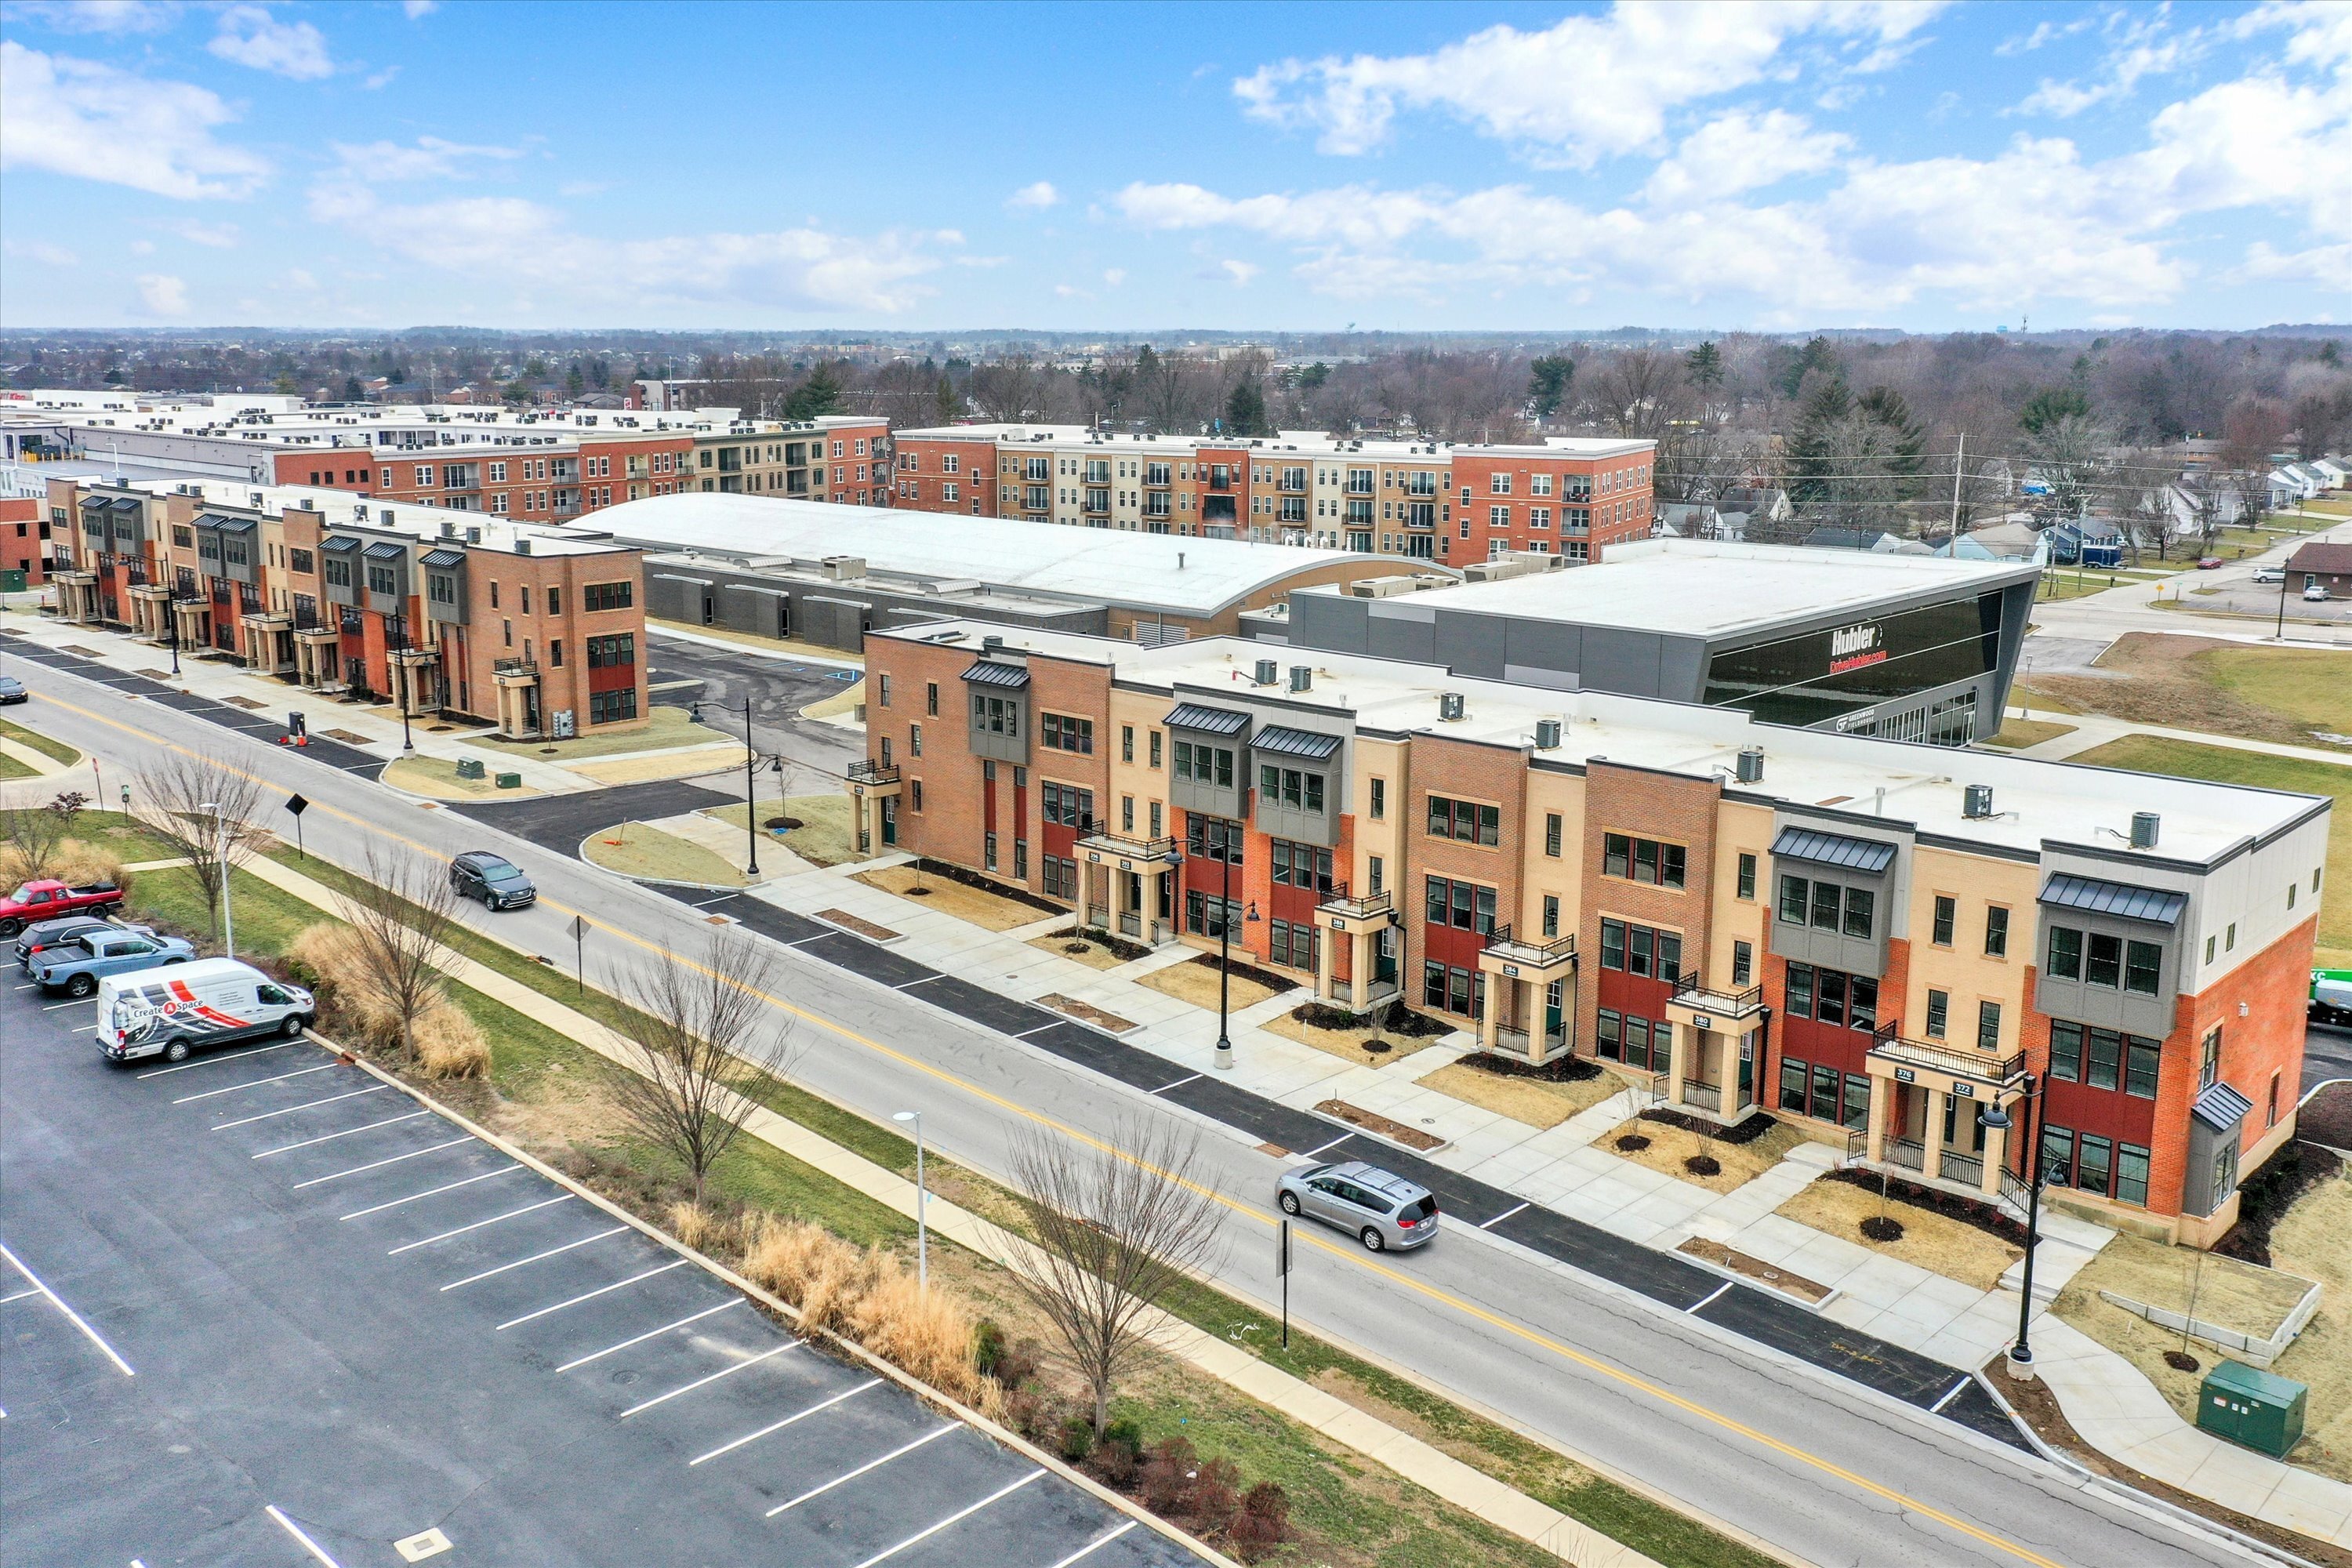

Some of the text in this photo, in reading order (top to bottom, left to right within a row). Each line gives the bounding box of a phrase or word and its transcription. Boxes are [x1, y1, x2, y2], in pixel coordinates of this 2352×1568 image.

[1831, 625, 1875, 657] Hubler
[1829, 650, 1887, 673] DriveHubler.com
[1849, 709, 1875, 721] GREENWOOD
[1848, 716, 1875, 728] FIELDHOUSE
[133, 1007, 163, 1018] Create
[176, 1000, 204, 1011] Space
[1695, 1015, 1708, 1024] 380
[1897, 1069, 1911, 1078] 376
[1955, 1083, 1970, 1092] 372
